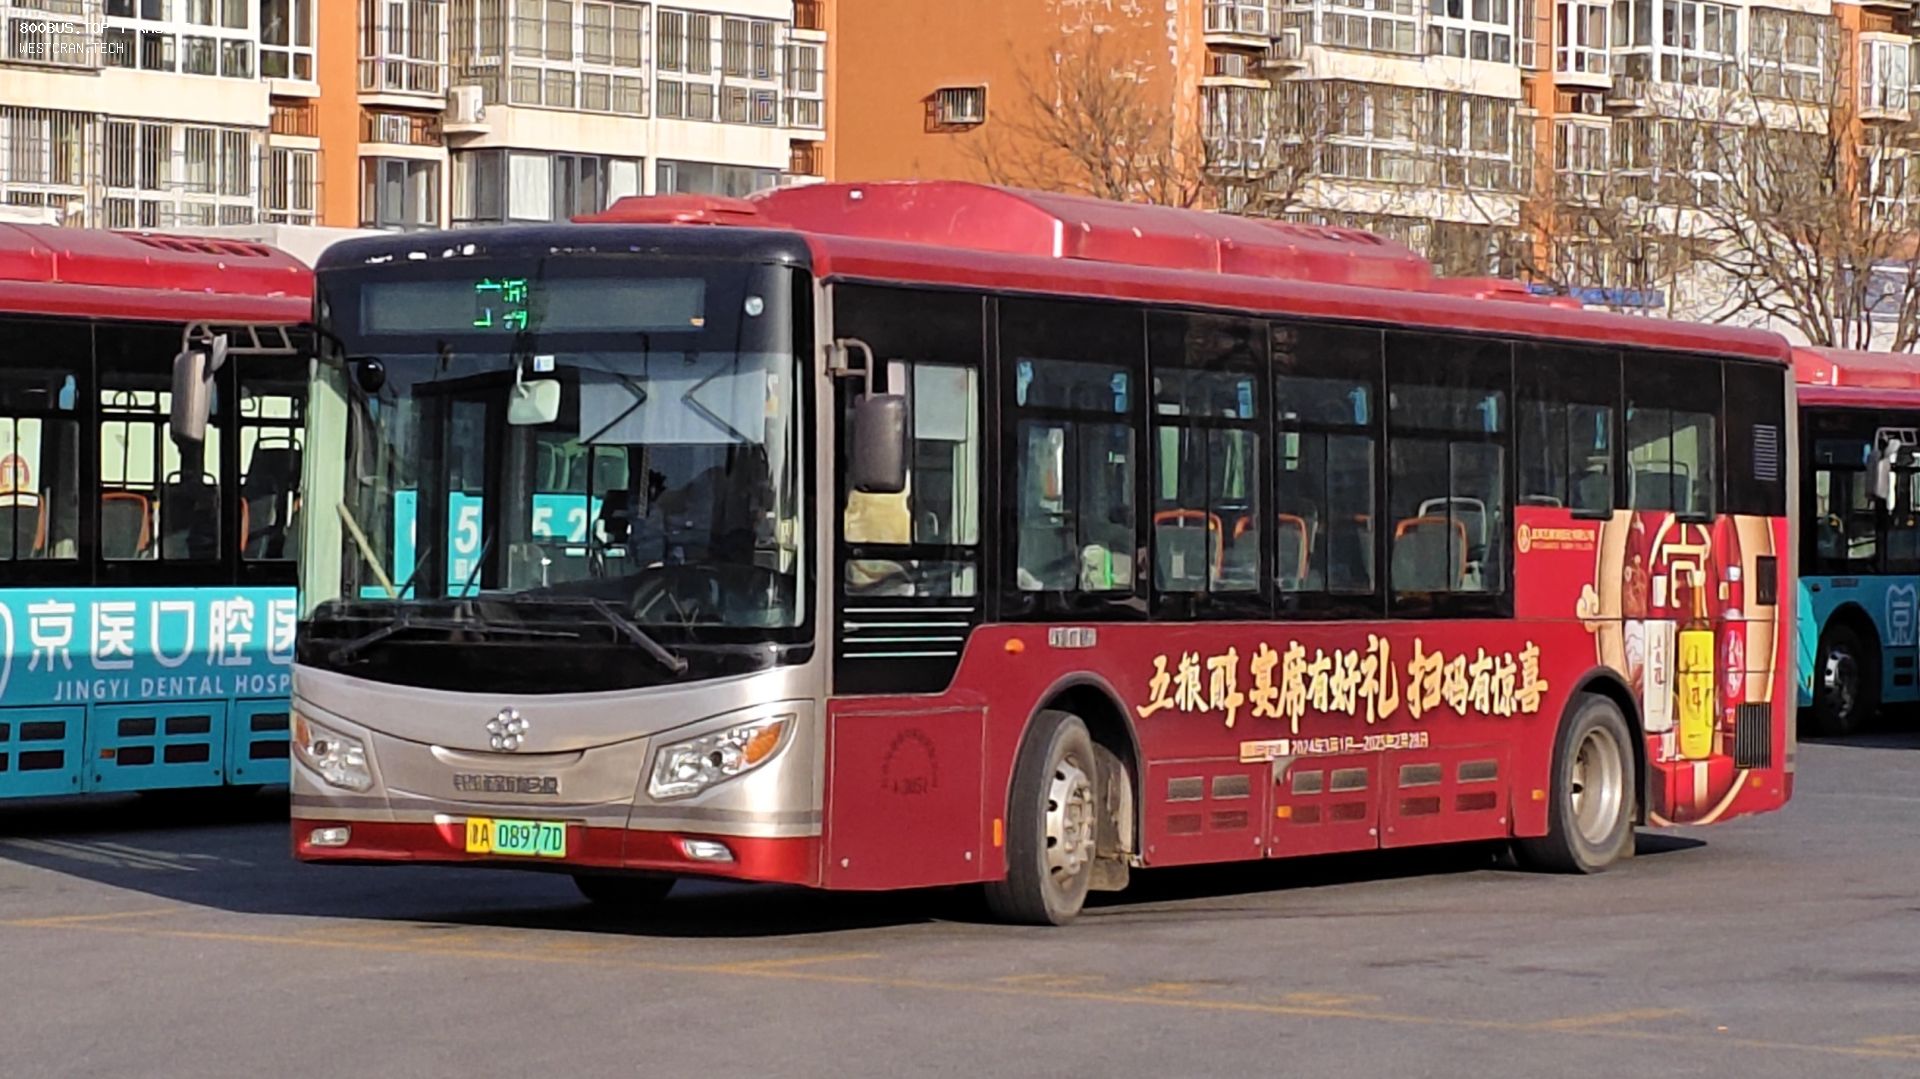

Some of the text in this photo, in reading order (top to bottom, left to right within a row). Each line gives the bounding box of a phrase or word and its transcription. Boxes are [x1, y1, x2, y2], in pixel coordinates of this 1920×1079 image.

[54, 673, 291, 701] JINGYI DENTAL HOSP
